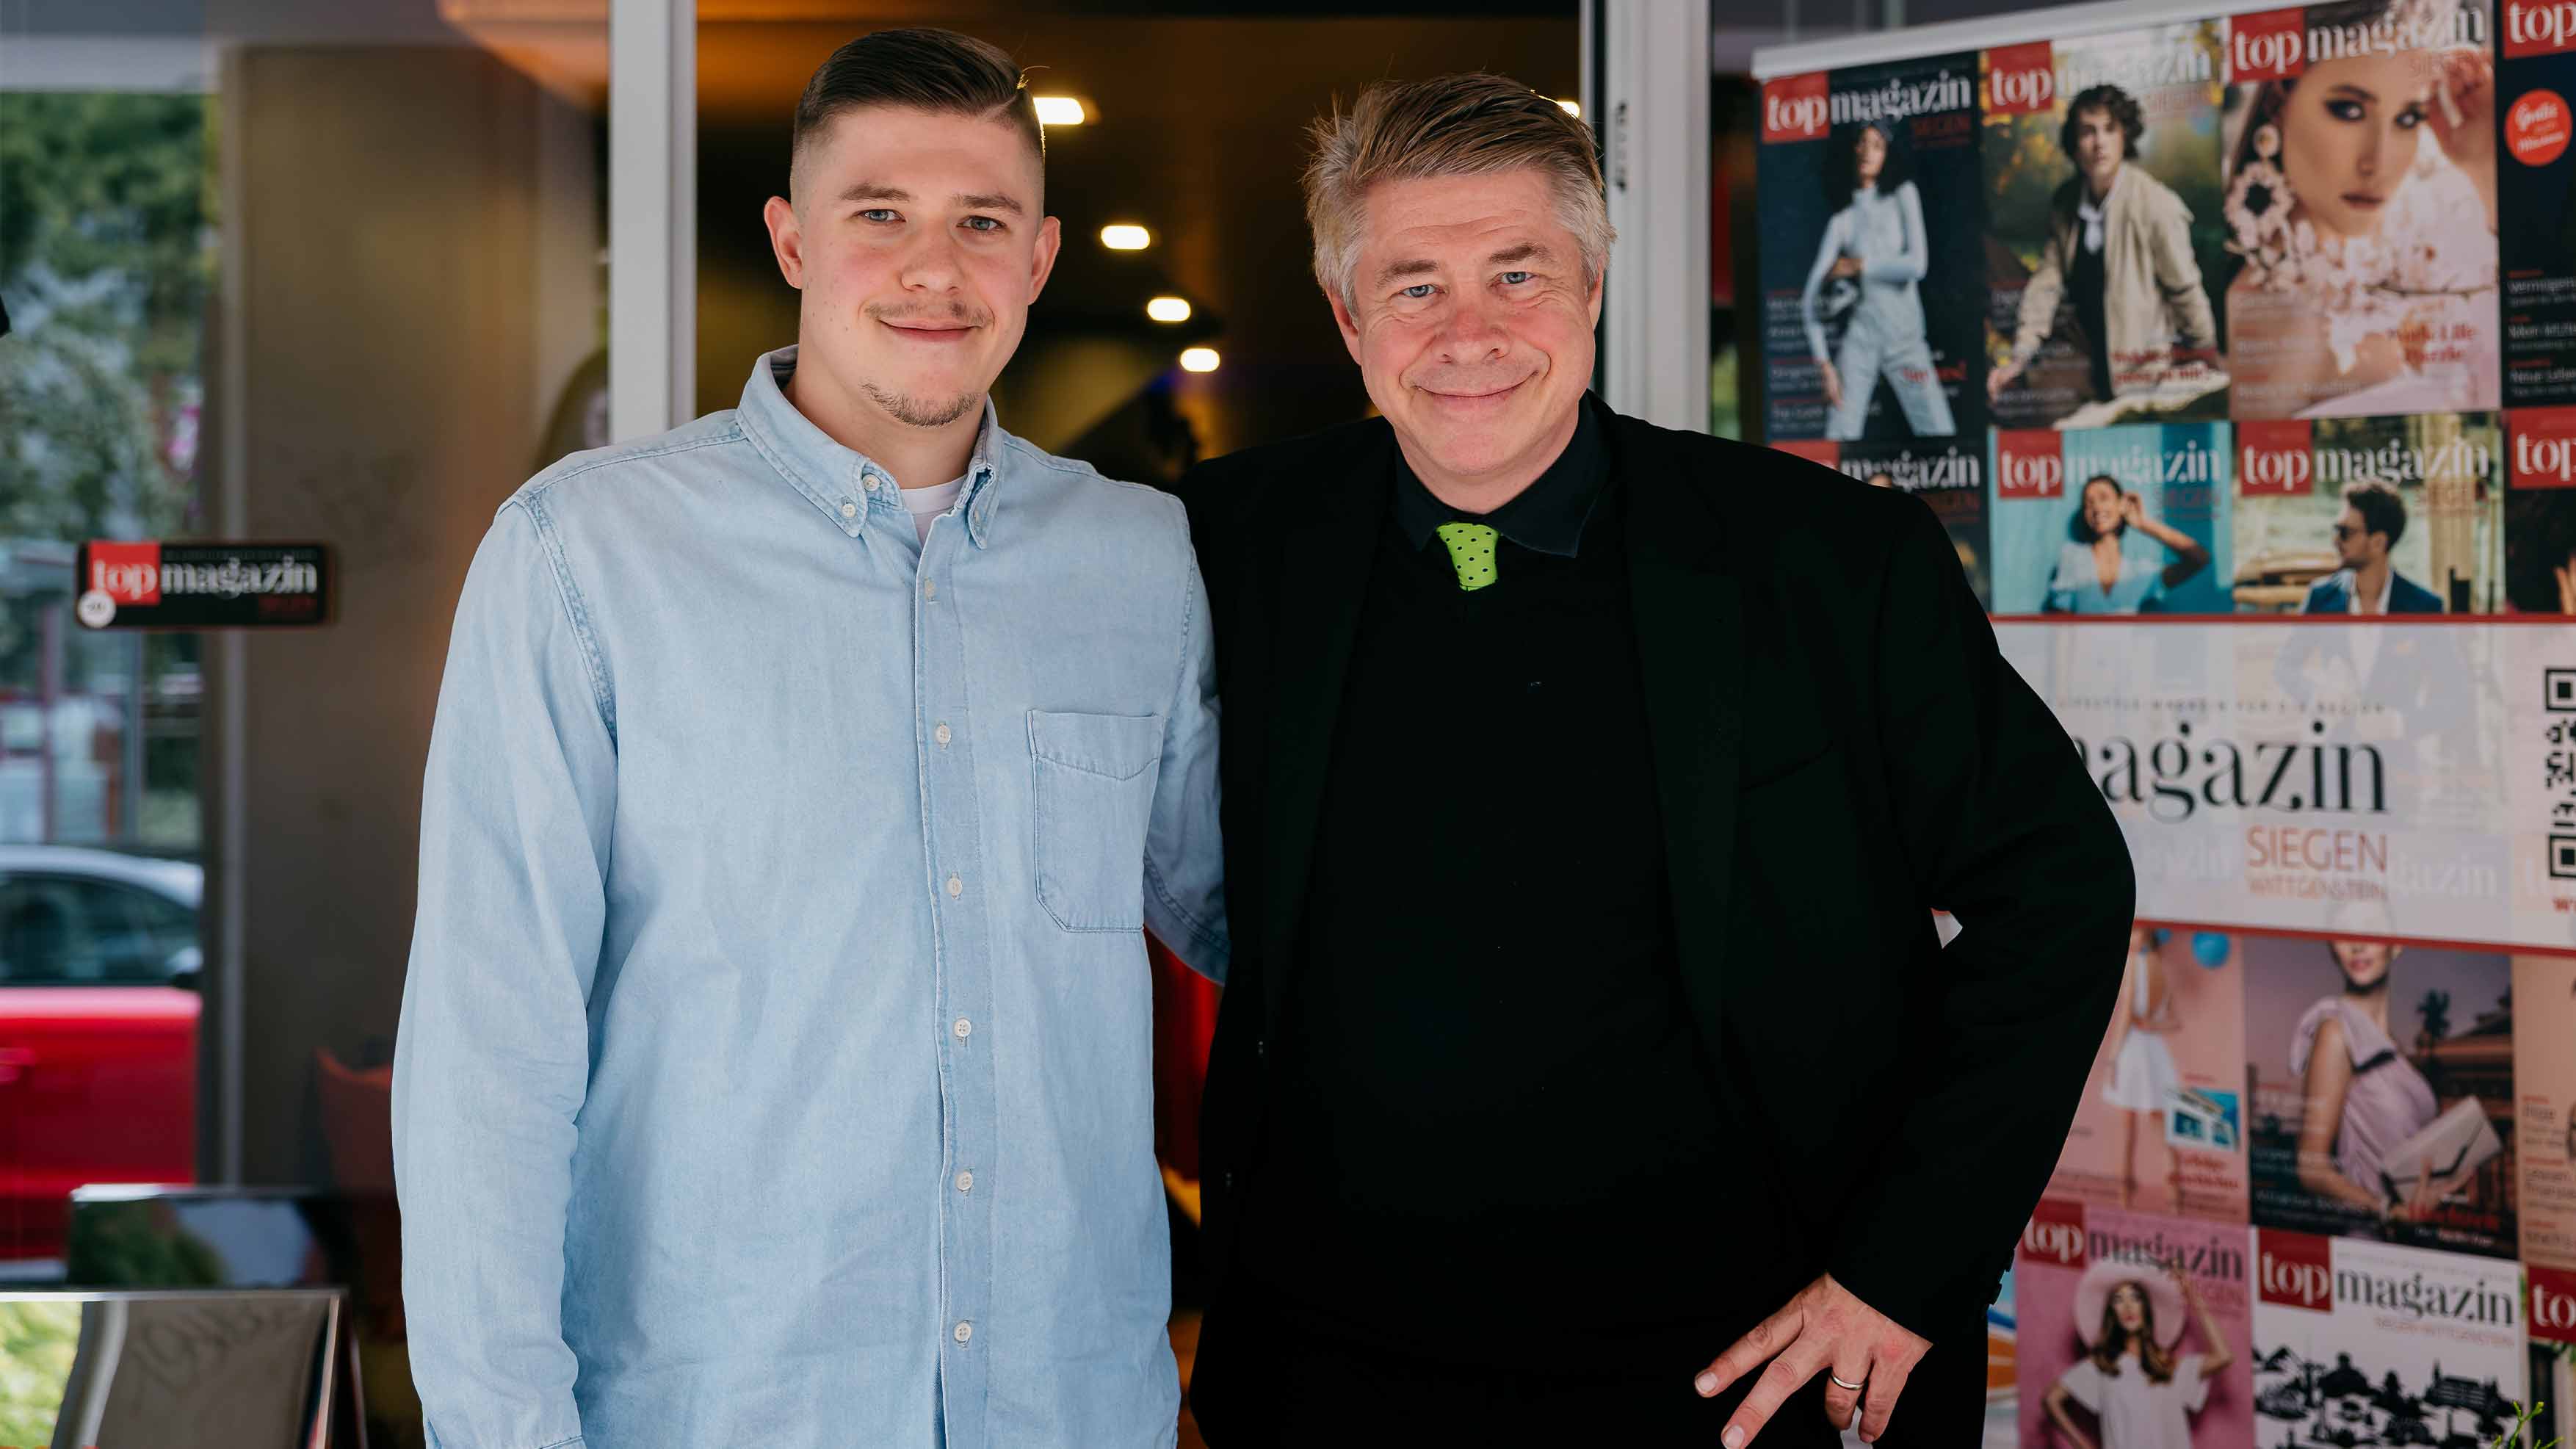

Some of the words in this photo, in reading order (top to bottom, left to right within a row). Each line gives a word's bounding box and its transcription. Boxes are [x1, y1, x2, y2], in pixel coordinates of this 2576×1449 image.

[2235, 29, 2301, 73] top
[1766, 93, 1827, 136] top
[1831, 71, 1972, 125] magazin
[1991, 67, 2052, 109] top
[2001, 450, 2062, 494] top
[2065, 438, 2222, 483] magazin
[2243, 444, 2310, 491] top
[2315, 436, 2490, 485] magazin
[93, 559, 158, 600] top
[160, 554, 318, 599] magazin
[2072, 721, 2392, 824] agazin
[2247, 824, 2387, 873] SIEGEN
[2022, 1217, 2084, 1263] top
[2089, 1230, 2243, 1282] magazin
[2262, 1251, 2329, 1305] top
[2337, 1271, 2513, 1327] magazin
[2533, 1283, 2576, 1329] to
